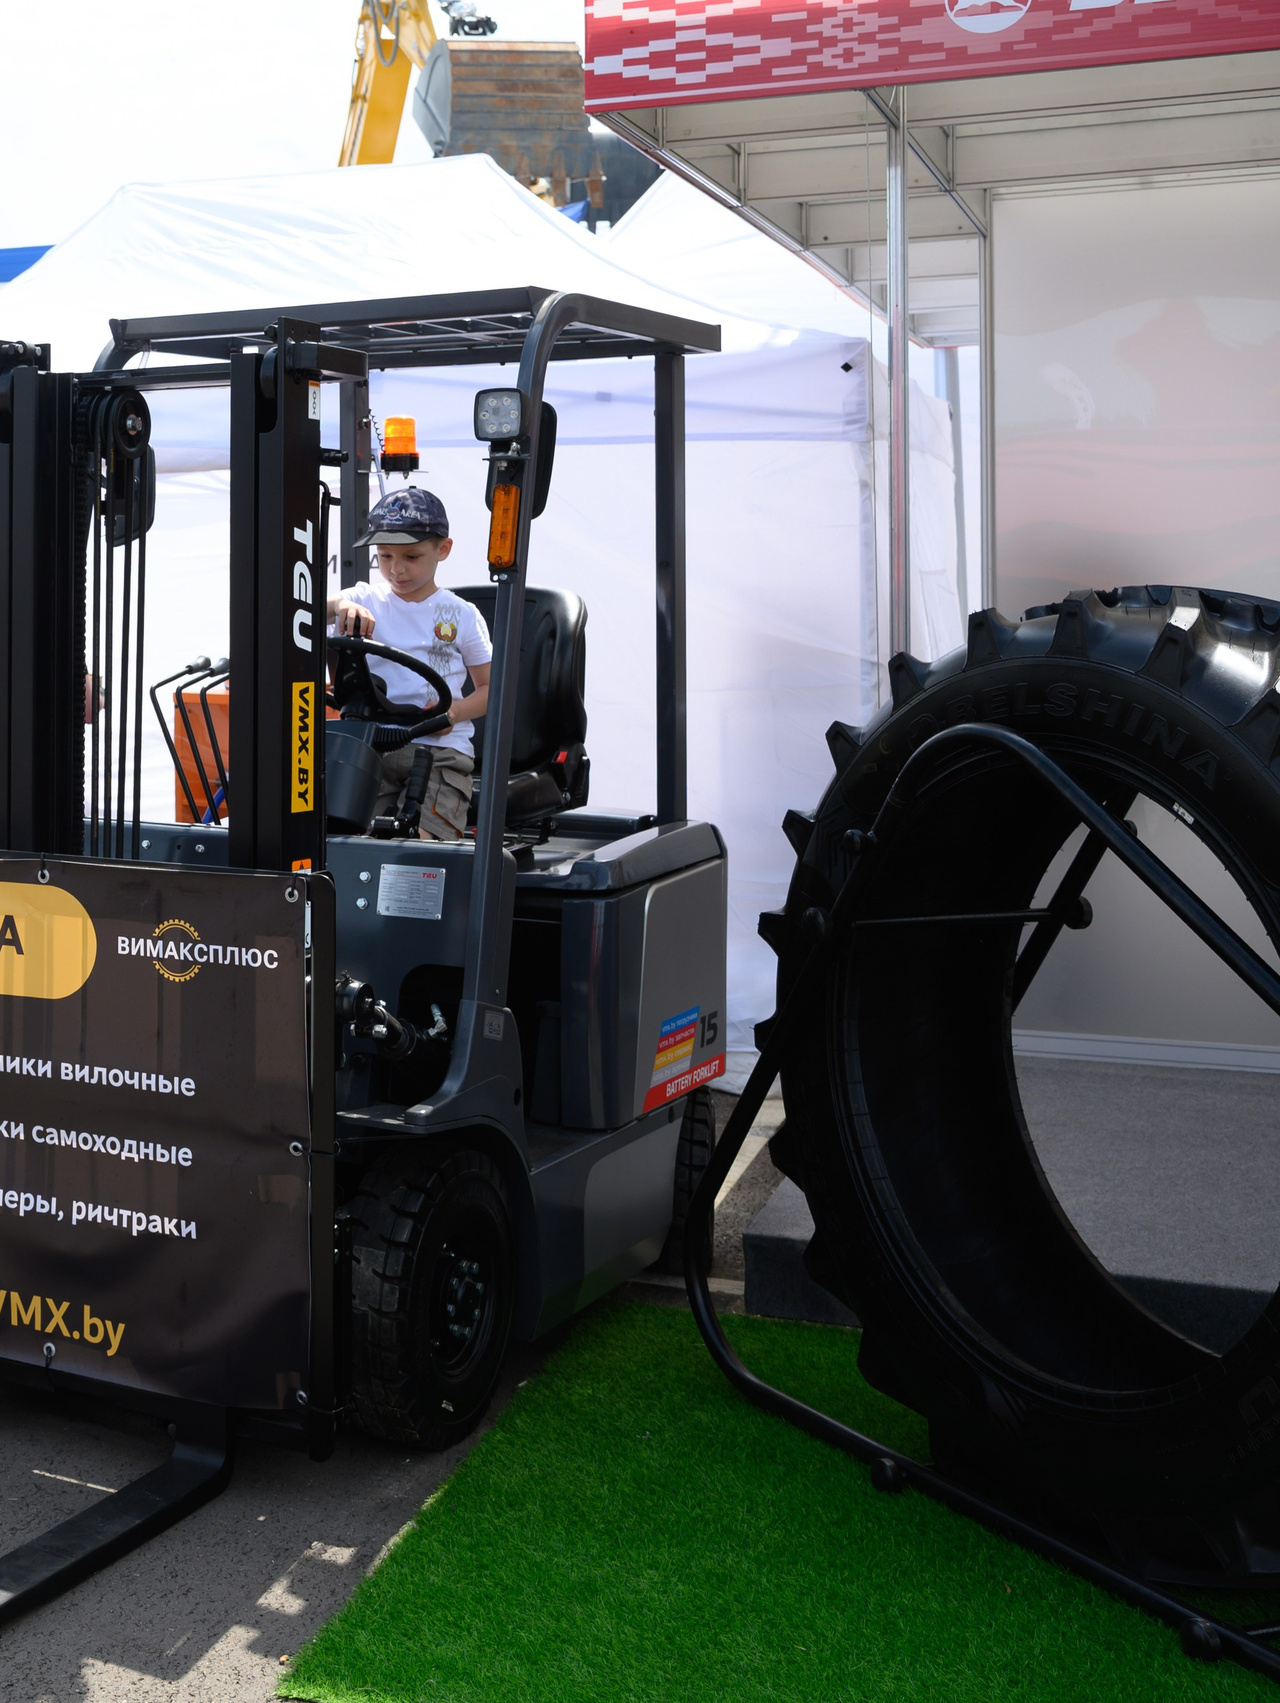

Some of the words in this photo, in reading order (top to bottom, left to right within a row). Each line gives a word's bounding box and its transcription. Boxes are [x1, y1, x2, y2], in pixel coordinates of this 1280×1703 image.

[297, 685, 310, 807] VMX.BY
[947, 682, 1220, 790] BELSHINA
[117, 935, 279, 970] ВИМАКСПЛЮС
[700, 1010, 718, 1049] 15
[60, 1062, 197, 1097] вилочные
[666, 1073, 692, 1097] BATTERY
[693, 1060, 719, 1084] FORKLIFT
[31, 1125, 193, 1167] самоходные
[72, 1199, 198, 1240] ричтраки
